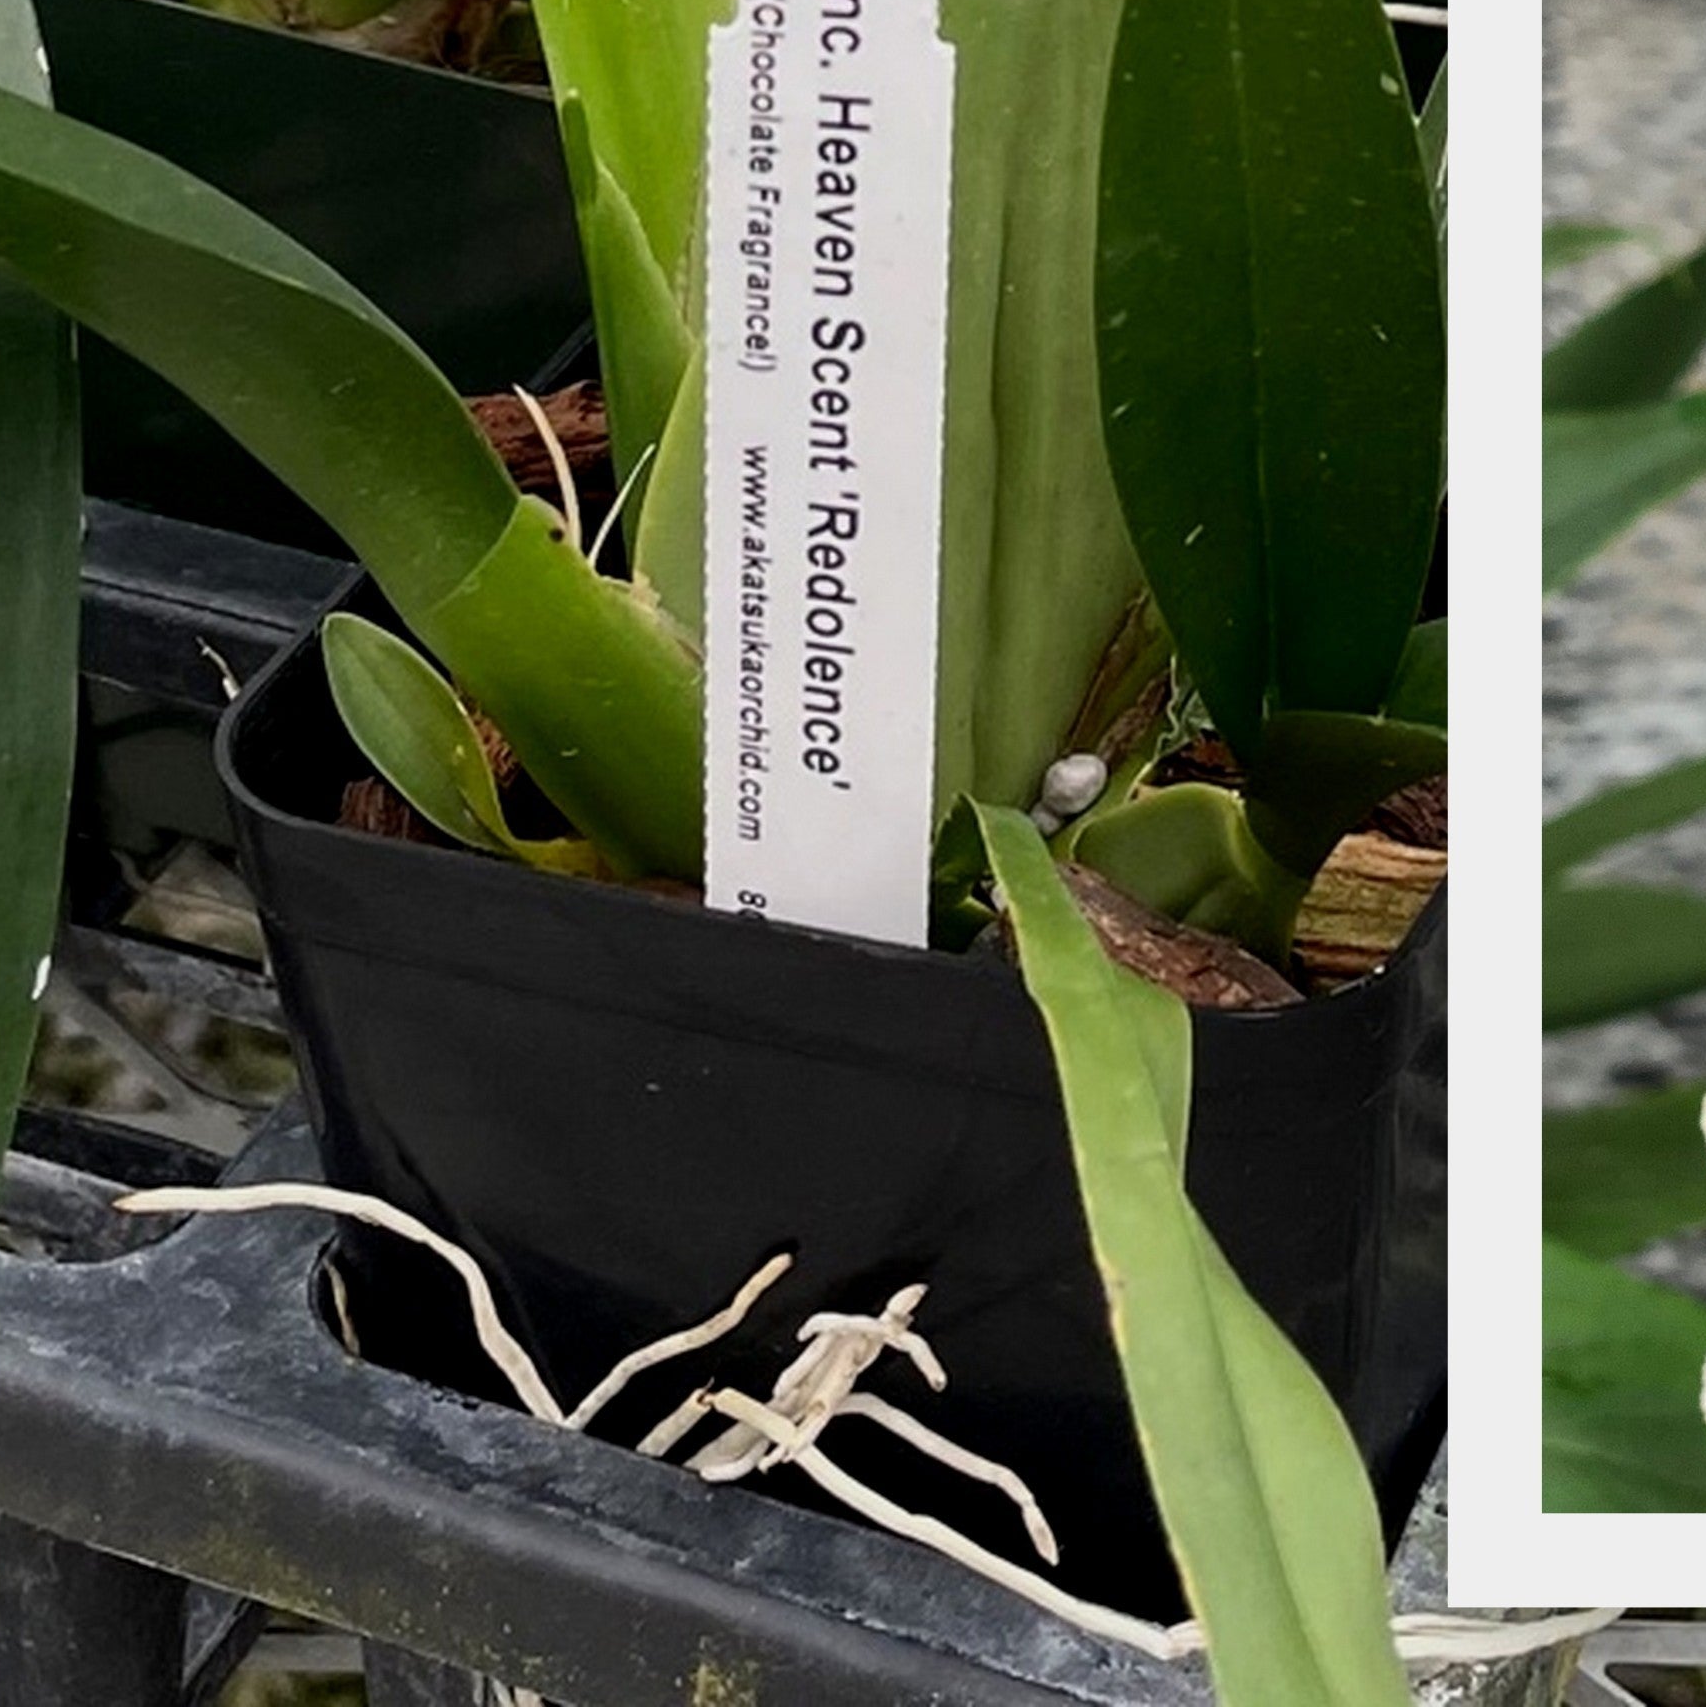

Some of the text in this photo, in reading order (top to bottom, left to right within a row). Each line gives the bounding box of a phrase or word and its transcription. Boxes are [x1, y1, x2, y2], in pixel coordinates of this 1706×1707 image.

[737, 184, 781, 373] Fragrance!)
[813, 93, 873, 298] Heaven
[808, 317, 866, 474] Scent
[738, 445, 773, 842] www.akatsukaorchid.com
[802, 491, 861, 791] 'Redolence'
